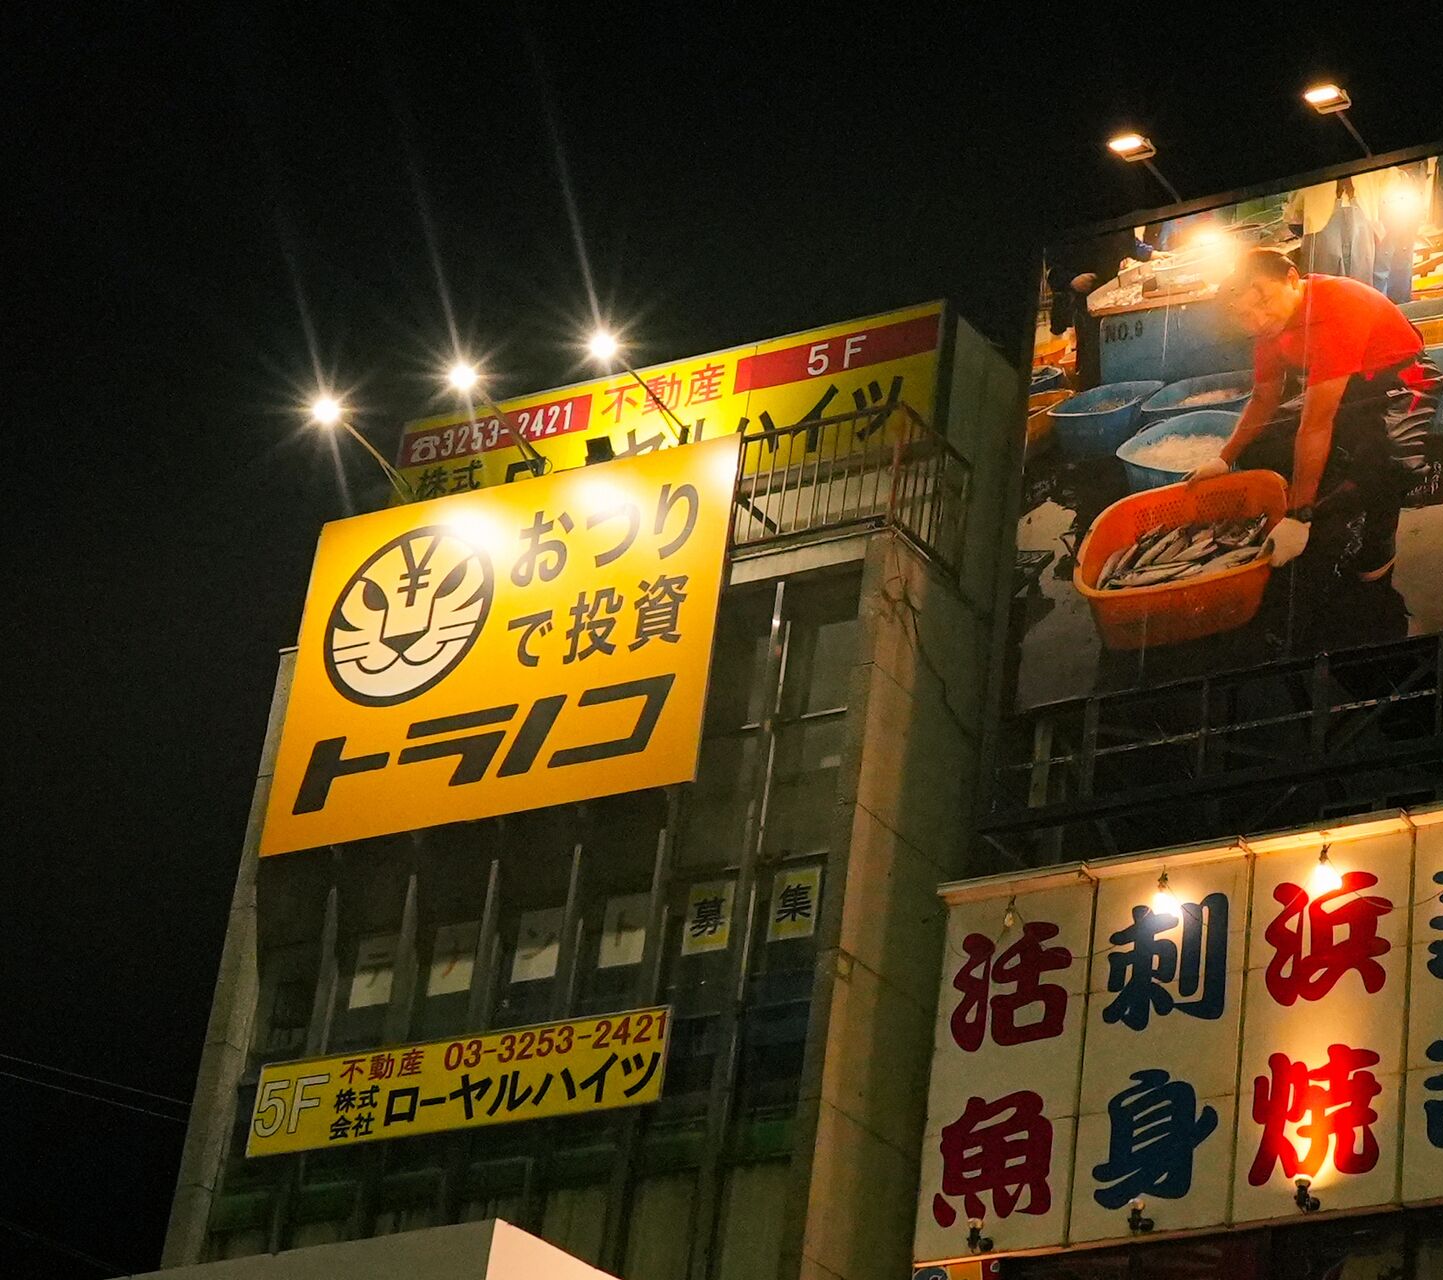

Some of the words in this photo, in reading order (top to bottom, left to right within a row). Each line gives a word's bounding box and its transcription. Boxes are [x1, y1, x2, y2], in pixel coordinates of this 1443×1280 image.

[600, 362, 726, 425] 不動産
[508, 481, 702, 590] おつり
[506, 573, 689, 669] で投資
[291, 673, 676, 816] トラノコ
[339, 1048, 425, 1086] 不動産
[443, 1010, 670, 1072] 03-3253-2421
[932, 920, 1073, 1230] 活魚
[1092, 890, 1228, 1210] 刺身
[1247, 868, 1392, 1188] 浜焼
[253, 1075, 332, 1139] 5F
[382, 1049, 662, 1130] ローヤルハイツ
